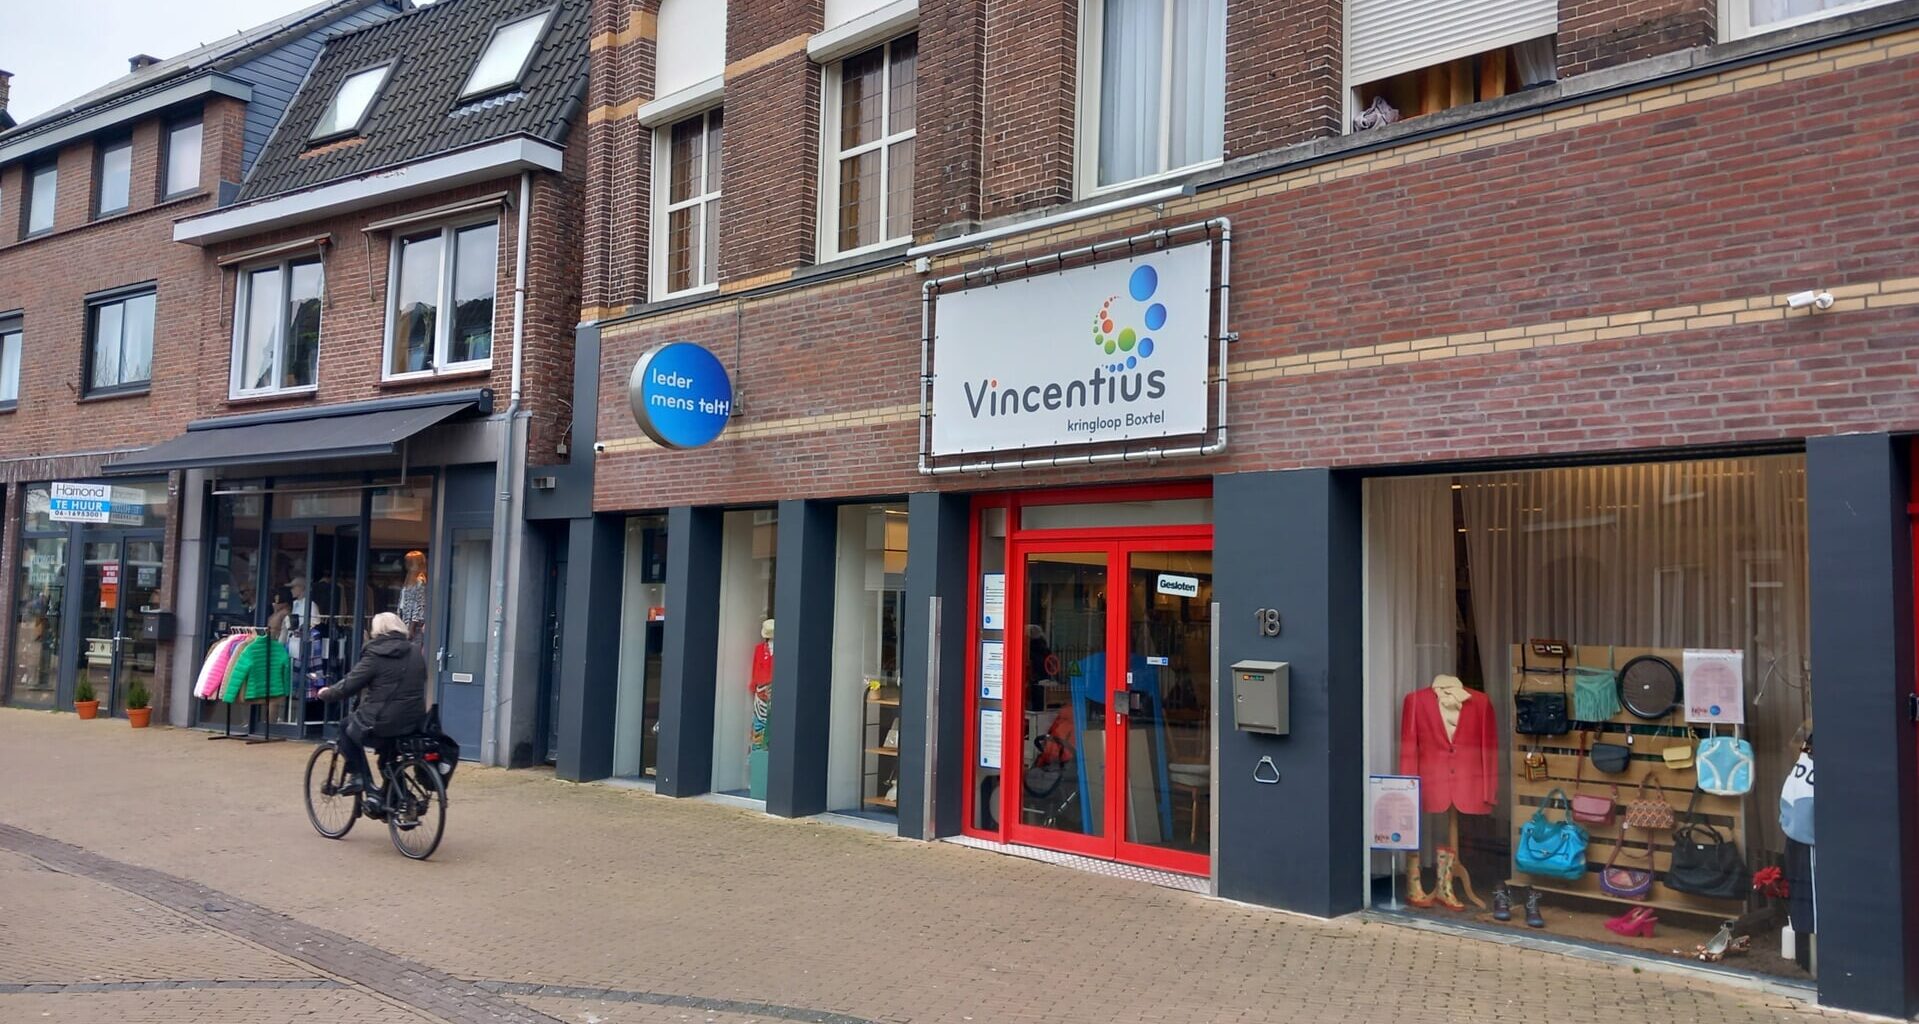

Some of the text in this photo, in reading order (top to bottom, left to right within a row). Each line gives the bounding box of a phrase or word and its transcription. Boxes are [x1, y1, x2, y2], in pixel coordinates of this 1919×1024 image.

[652, 367, 693, 389] Ieder
[964, 367, 1166, 418] Vincentius
[651, 394, 730, 416] mens telt!
[1067, 410, 1165, 433] kringloop Boxtel
[56, 484, 105, 497] Hamond
[55, 500, 68, 510] TE
[71, 501, 103, 511] HUUR
[1160, 579, 1196, 592] Gesloten
[1254, 608, 1281, 637] 18
